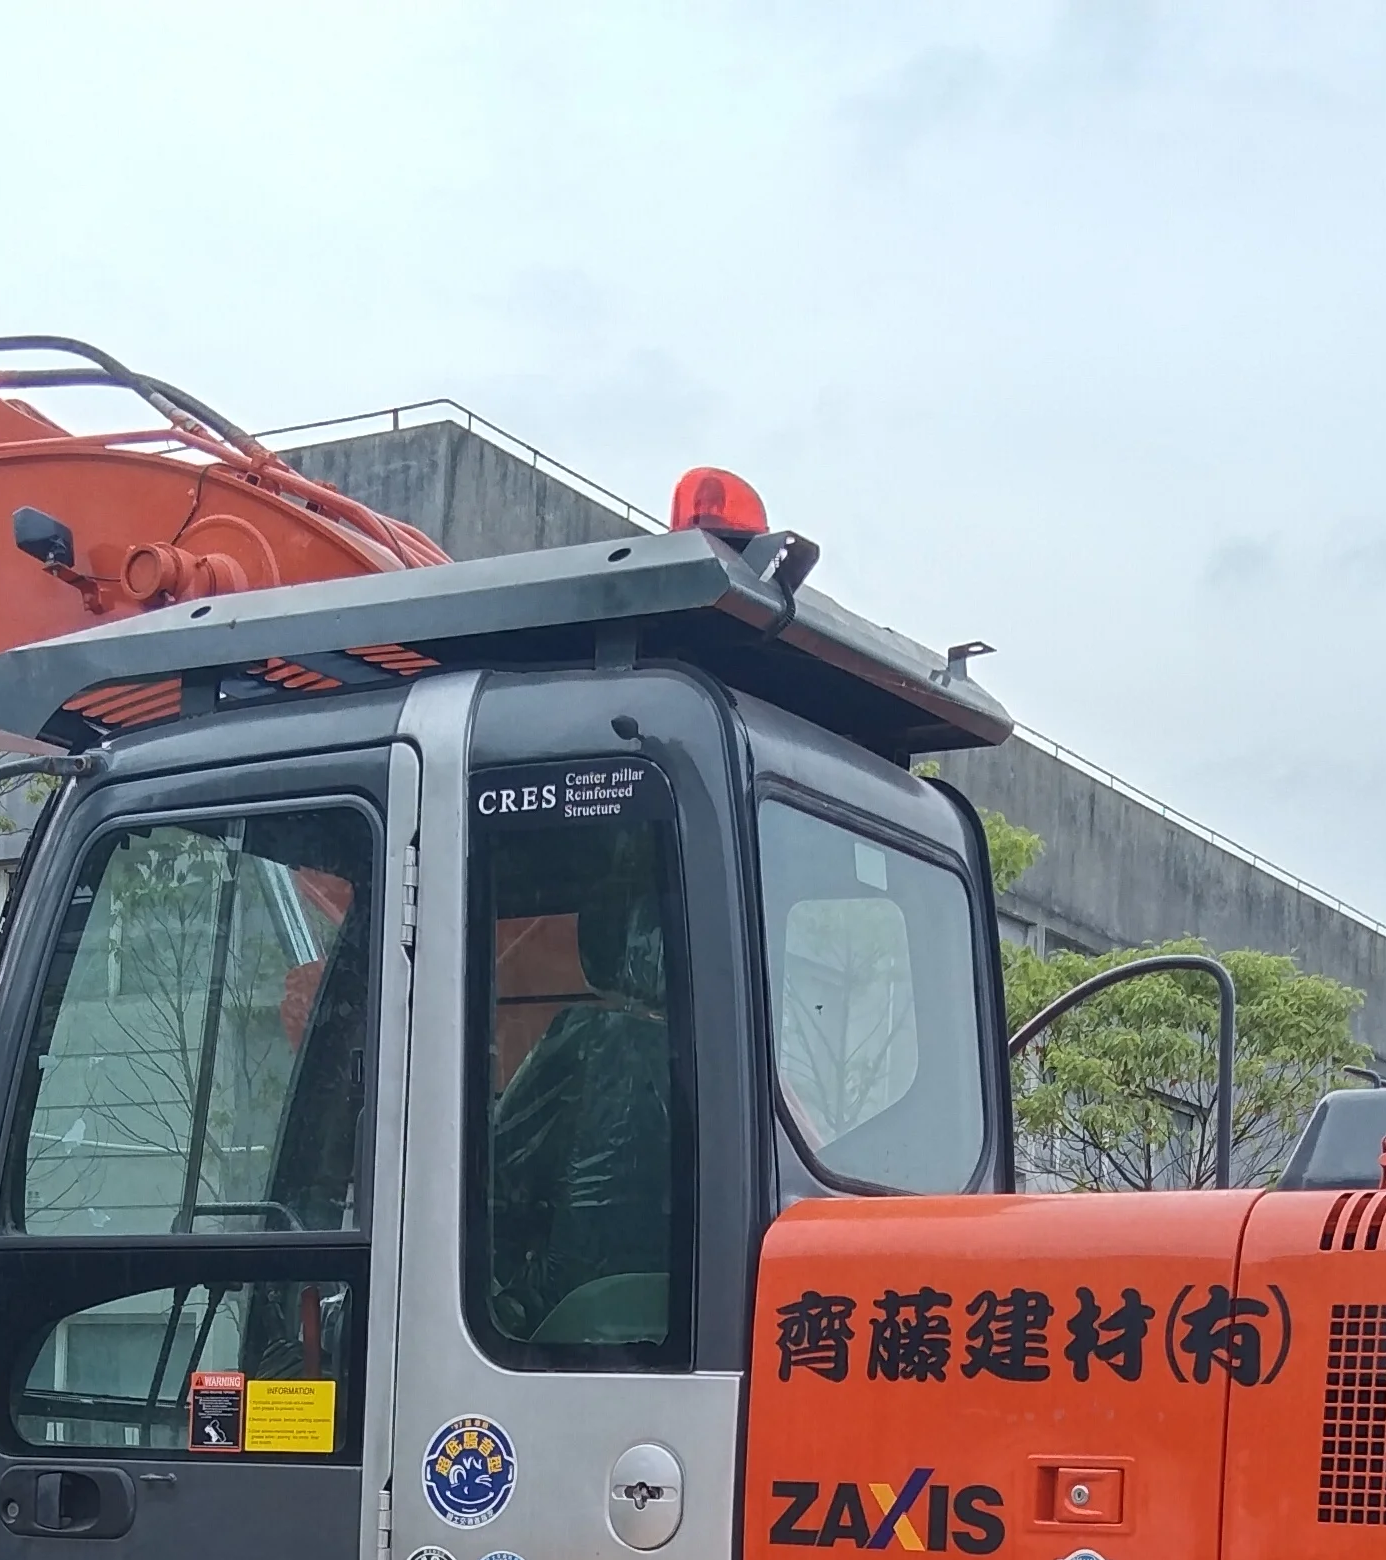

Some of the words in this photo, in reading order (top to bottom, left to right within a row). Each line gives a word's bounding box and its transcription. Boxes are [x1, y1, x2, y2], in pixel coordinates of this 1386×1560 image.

[565, 771, 607, 786] Center
[612, 768, 645, 786] pillar
[477, 784, 557, 815] CRES
[565, 783, 633, 802] Reinforced
[564, 803, 621, 818] Structure
[204, 1376, 241, 1388] WARNING
[267, 1386, 315, 1395] INFORMATION
[769, 1467, 1006, 1555] ZAXIS
